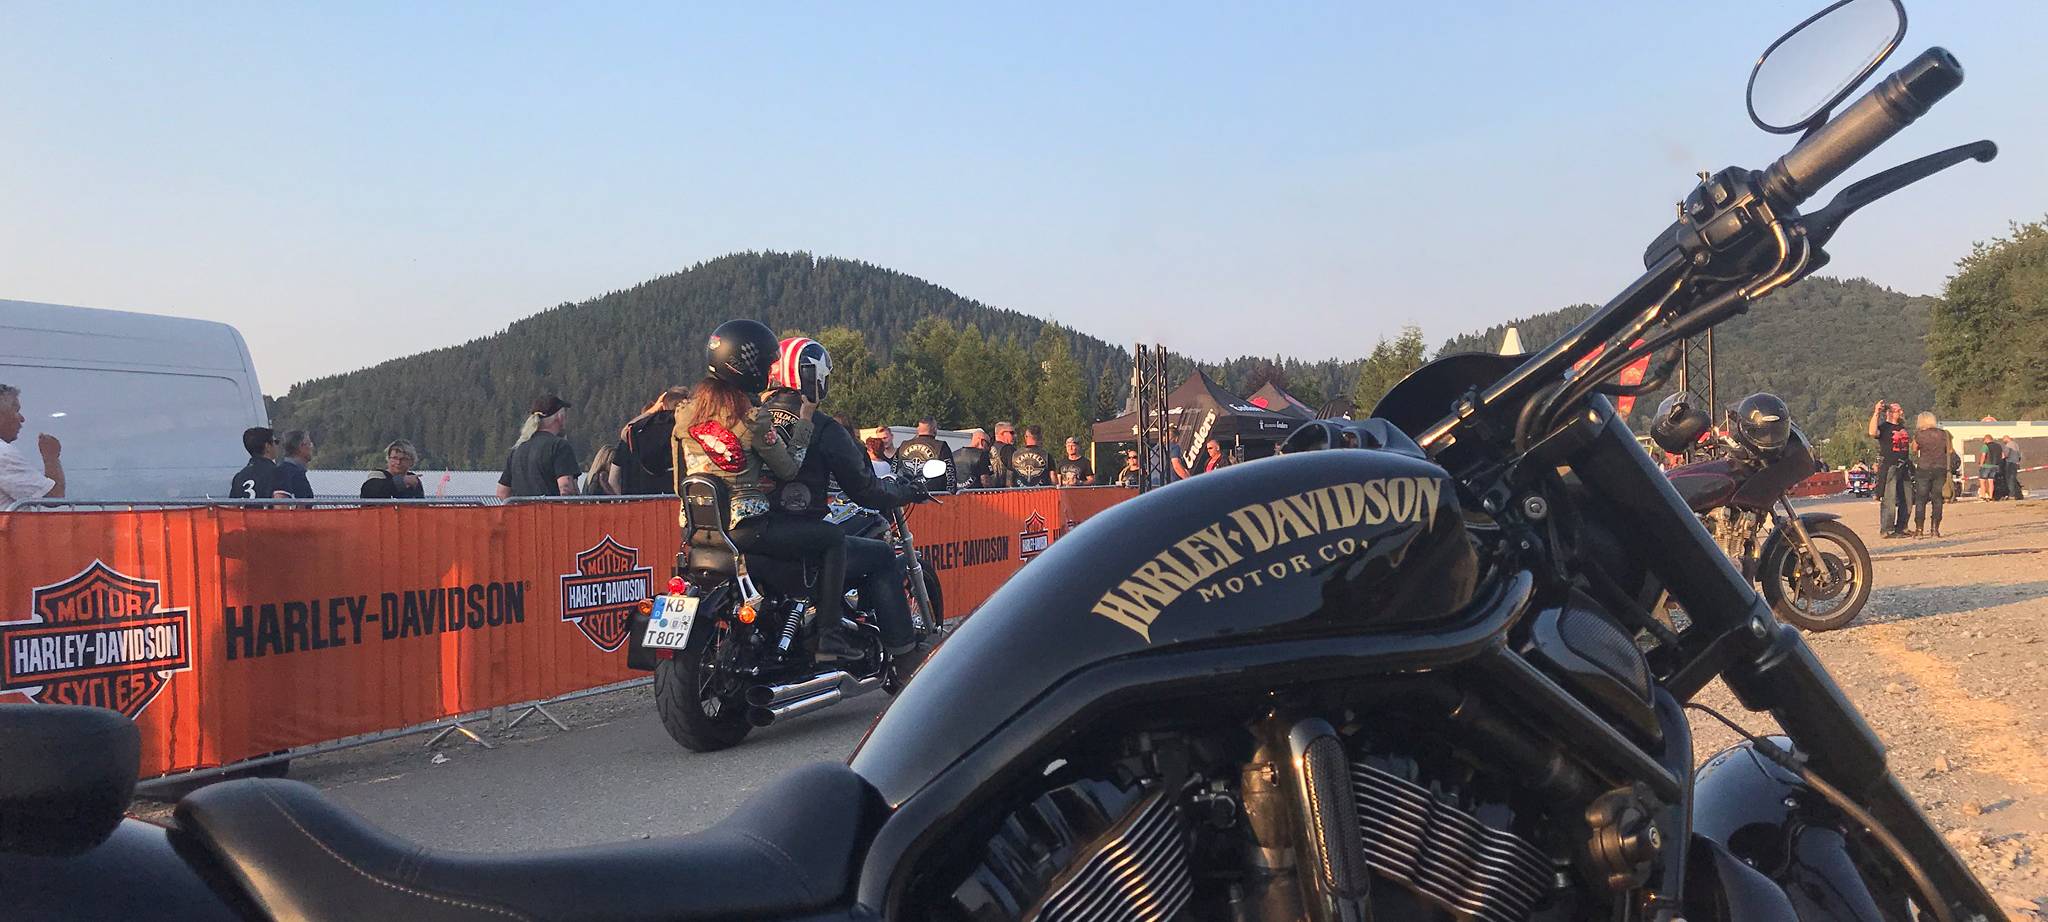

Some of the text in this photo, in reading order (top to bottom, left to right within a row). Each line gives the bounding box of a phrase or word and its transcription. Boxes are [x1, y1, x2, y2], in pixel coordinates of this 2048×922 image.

[1183, 408, 1216, 469] Enders
[242, 479, 257, 500] 3
[587, 550, 629, 576] MOTOR
[1197, 554, 1312, 603] MOTOR
[57, 580, 143, 623] MOTOR
[568, 578, 647, 609] HARLEY-DAVIDSON
[665, 599, 686, 613] KB
[14, 625, 179, 674] HARLEY-DAVIDSON
